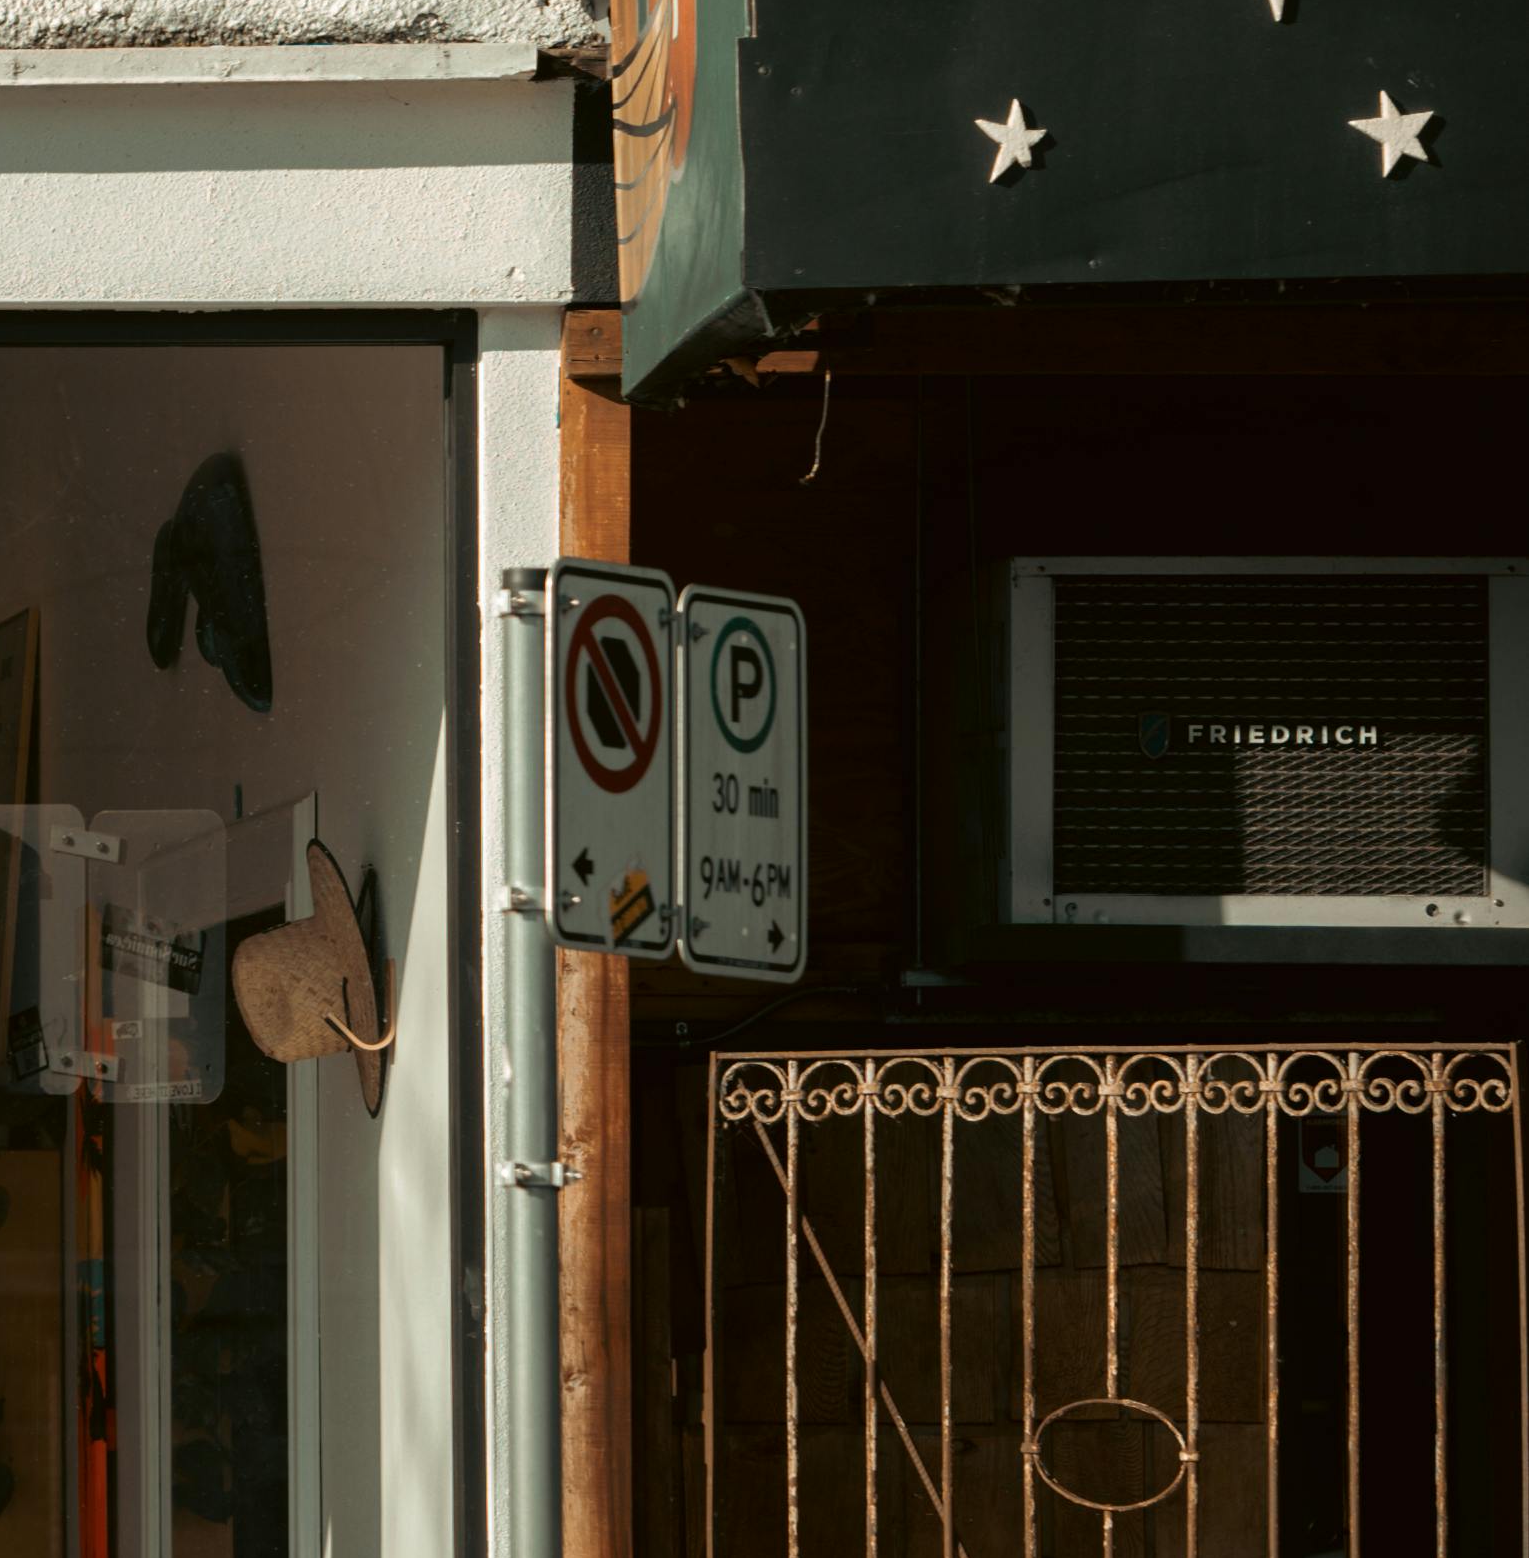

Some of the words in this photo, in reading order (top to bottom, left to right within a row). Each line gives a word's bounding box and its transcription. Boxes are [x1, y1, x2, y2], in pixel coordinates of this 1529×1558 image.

[730, 644, 763, 723] P
[1187, 724, 1378, 744] FRIEDRICH
[711, 772, 739, 815] 30
[747, 778, 779, 819] min
